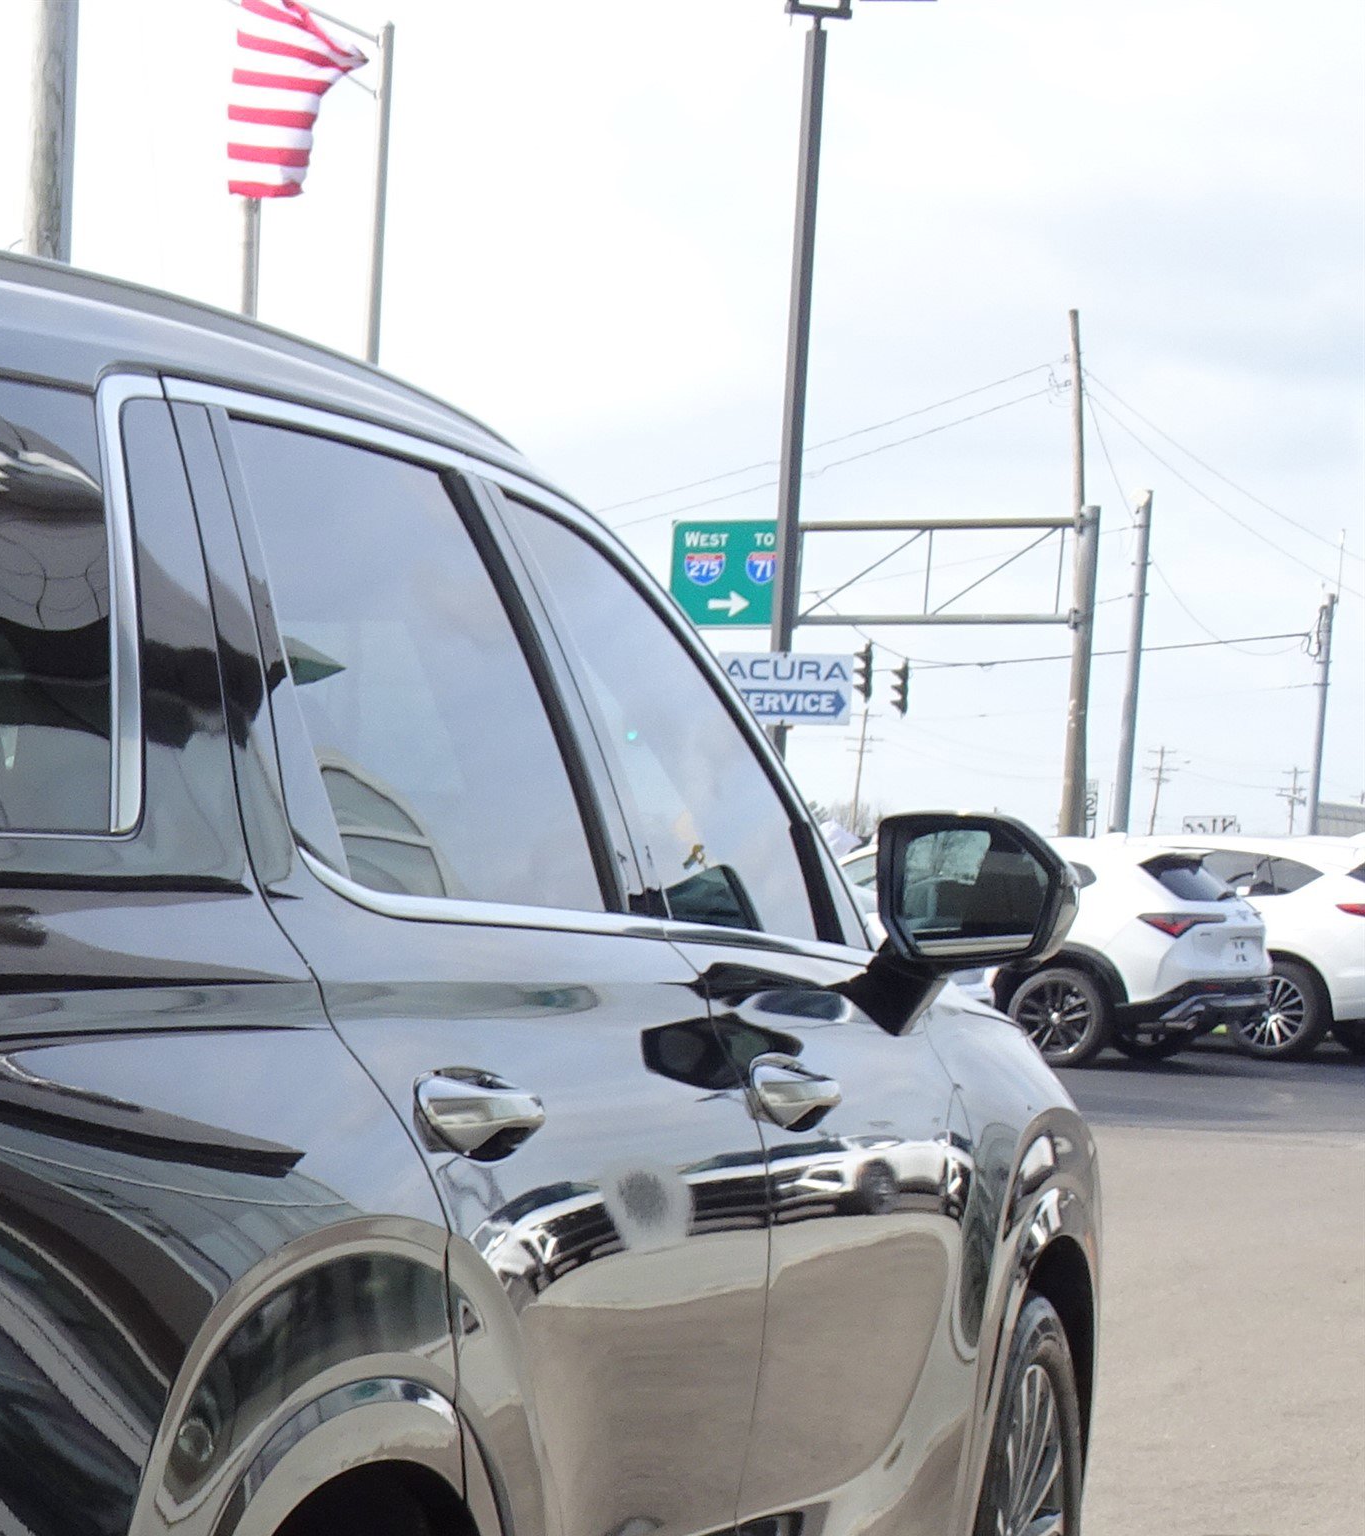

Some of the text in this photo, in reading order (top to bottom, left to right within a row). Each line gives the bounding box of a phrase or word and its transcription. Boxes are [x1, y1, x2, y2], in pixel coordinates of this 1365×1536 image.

[754, 532, 776, 547] TO
[689, 559, 772, 578] 275 71
[727, 659, 848, 681] ACURA
